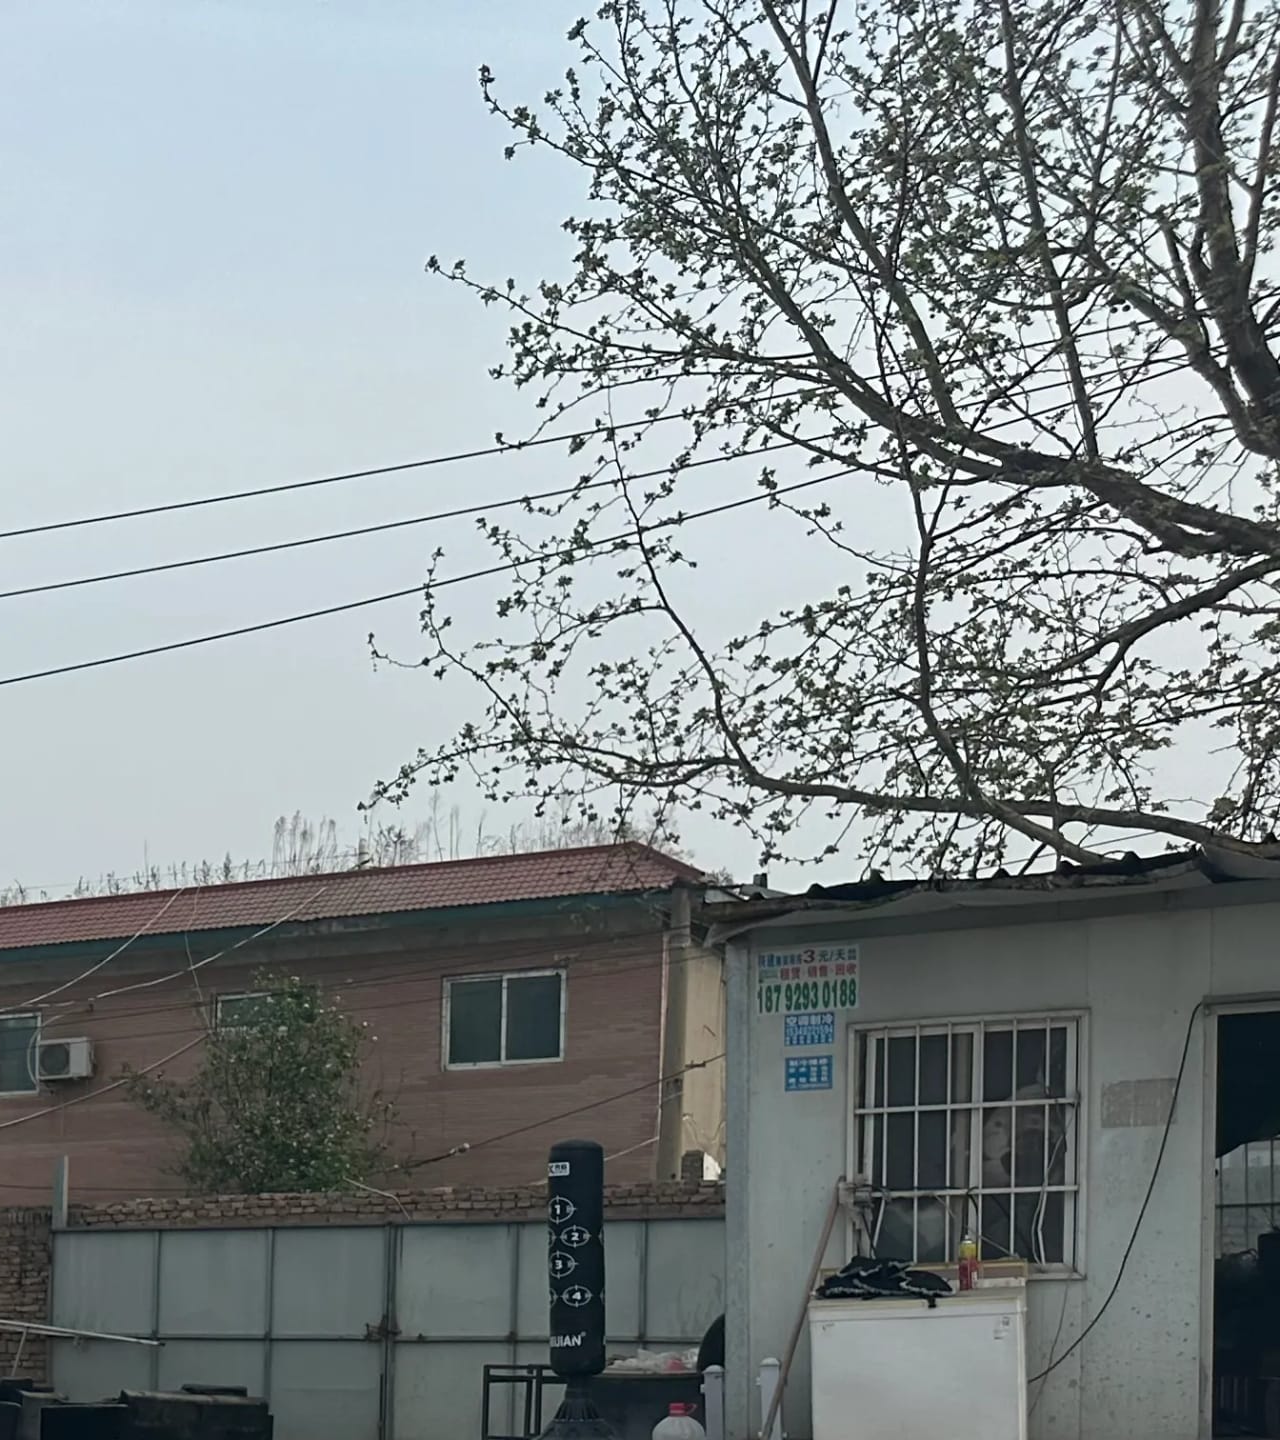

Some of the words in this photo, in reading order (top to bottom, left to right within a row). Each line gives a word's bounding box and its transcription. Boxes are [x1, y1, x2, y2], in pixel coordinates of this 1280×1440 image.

[758, 985, 781, 1013] 187
[785, 982, 818, 1011] 9293
[823, 978, 856, 1008] 0188
[555, 1205, 560, 1215] 1
[571, 1232, 579, 1240] 2
[555, 1260, 562, 1270] 3
[572, 1292, 582, 1300] 4
